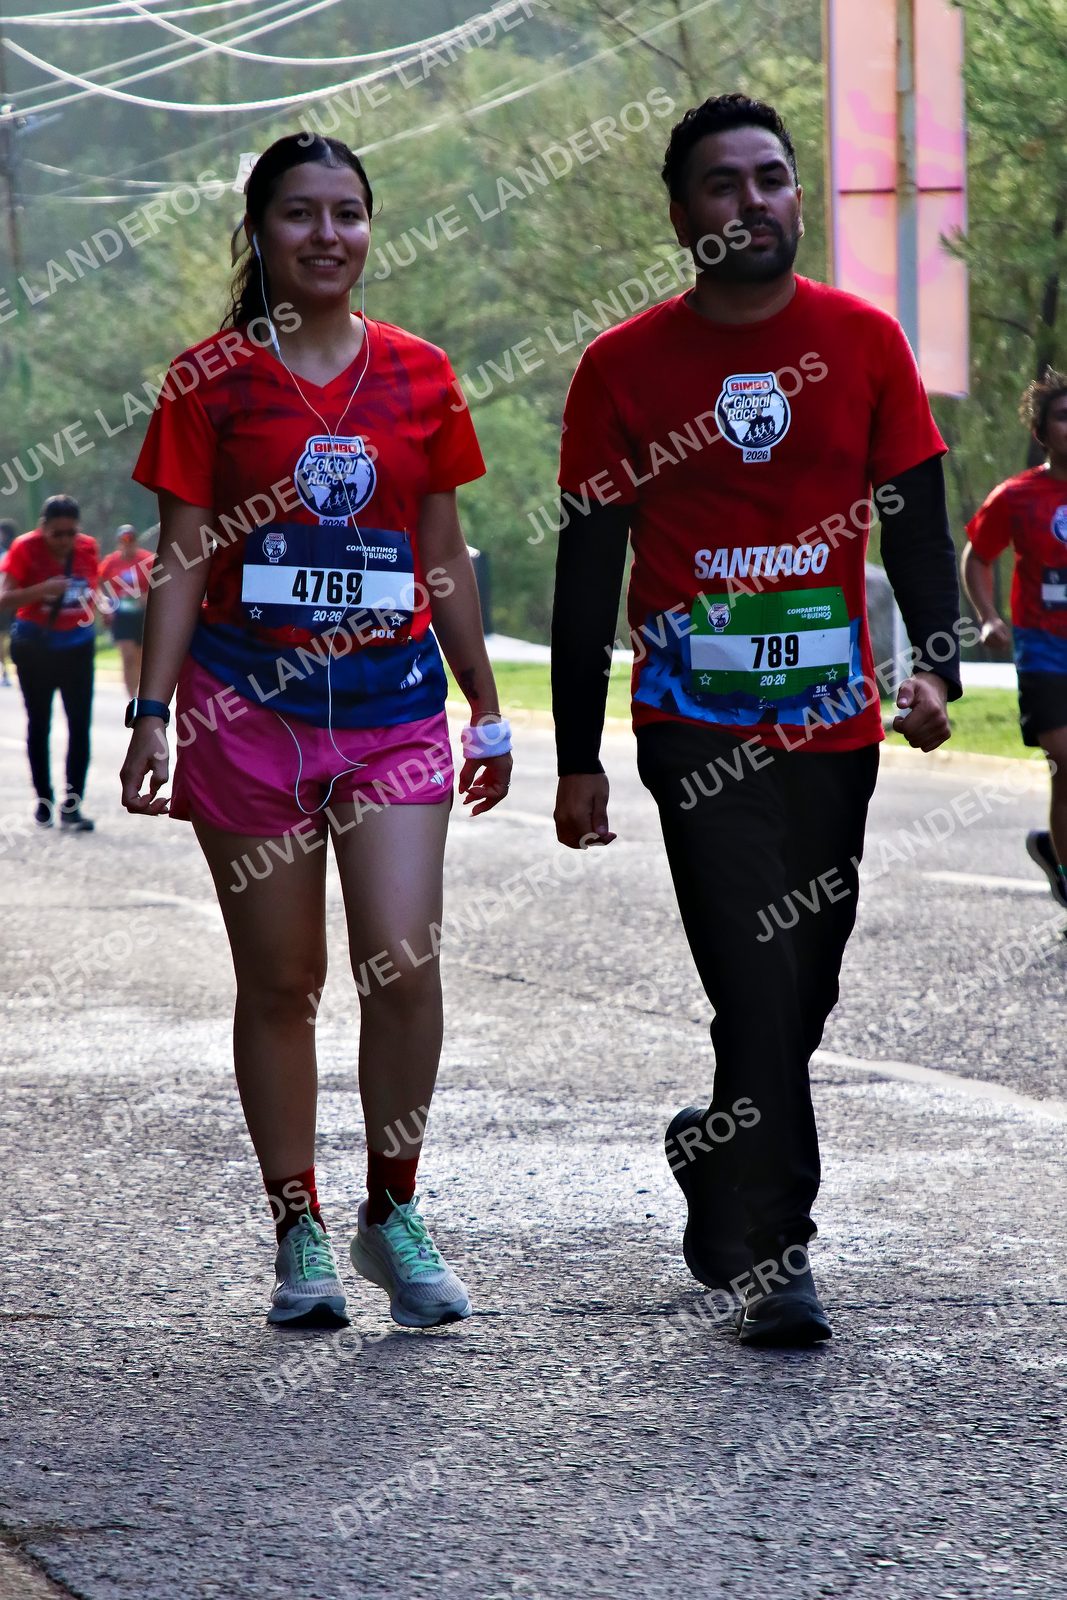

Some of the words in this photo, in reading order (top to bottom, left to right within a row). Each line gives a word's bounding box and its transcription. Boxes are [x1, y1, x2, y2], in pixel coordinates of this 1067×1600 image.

[731, 381, 770, 391] BIMBO
[733, 395, 771, 409] Global
[727, 408, 758, 421] Race
[313, 442, 358, 454] BIMBO
[745, 450, 769, 461] 2026
[316, 457, 357, 474] Global
[307, 471, 340, 486] Race
[346, 545, 398, 554] COMPARTIMOS
[694, 543, 829, 579] SANTIAGO
[292, 569, 363, 606] 4769
[751, 634, 799, 669] 789
